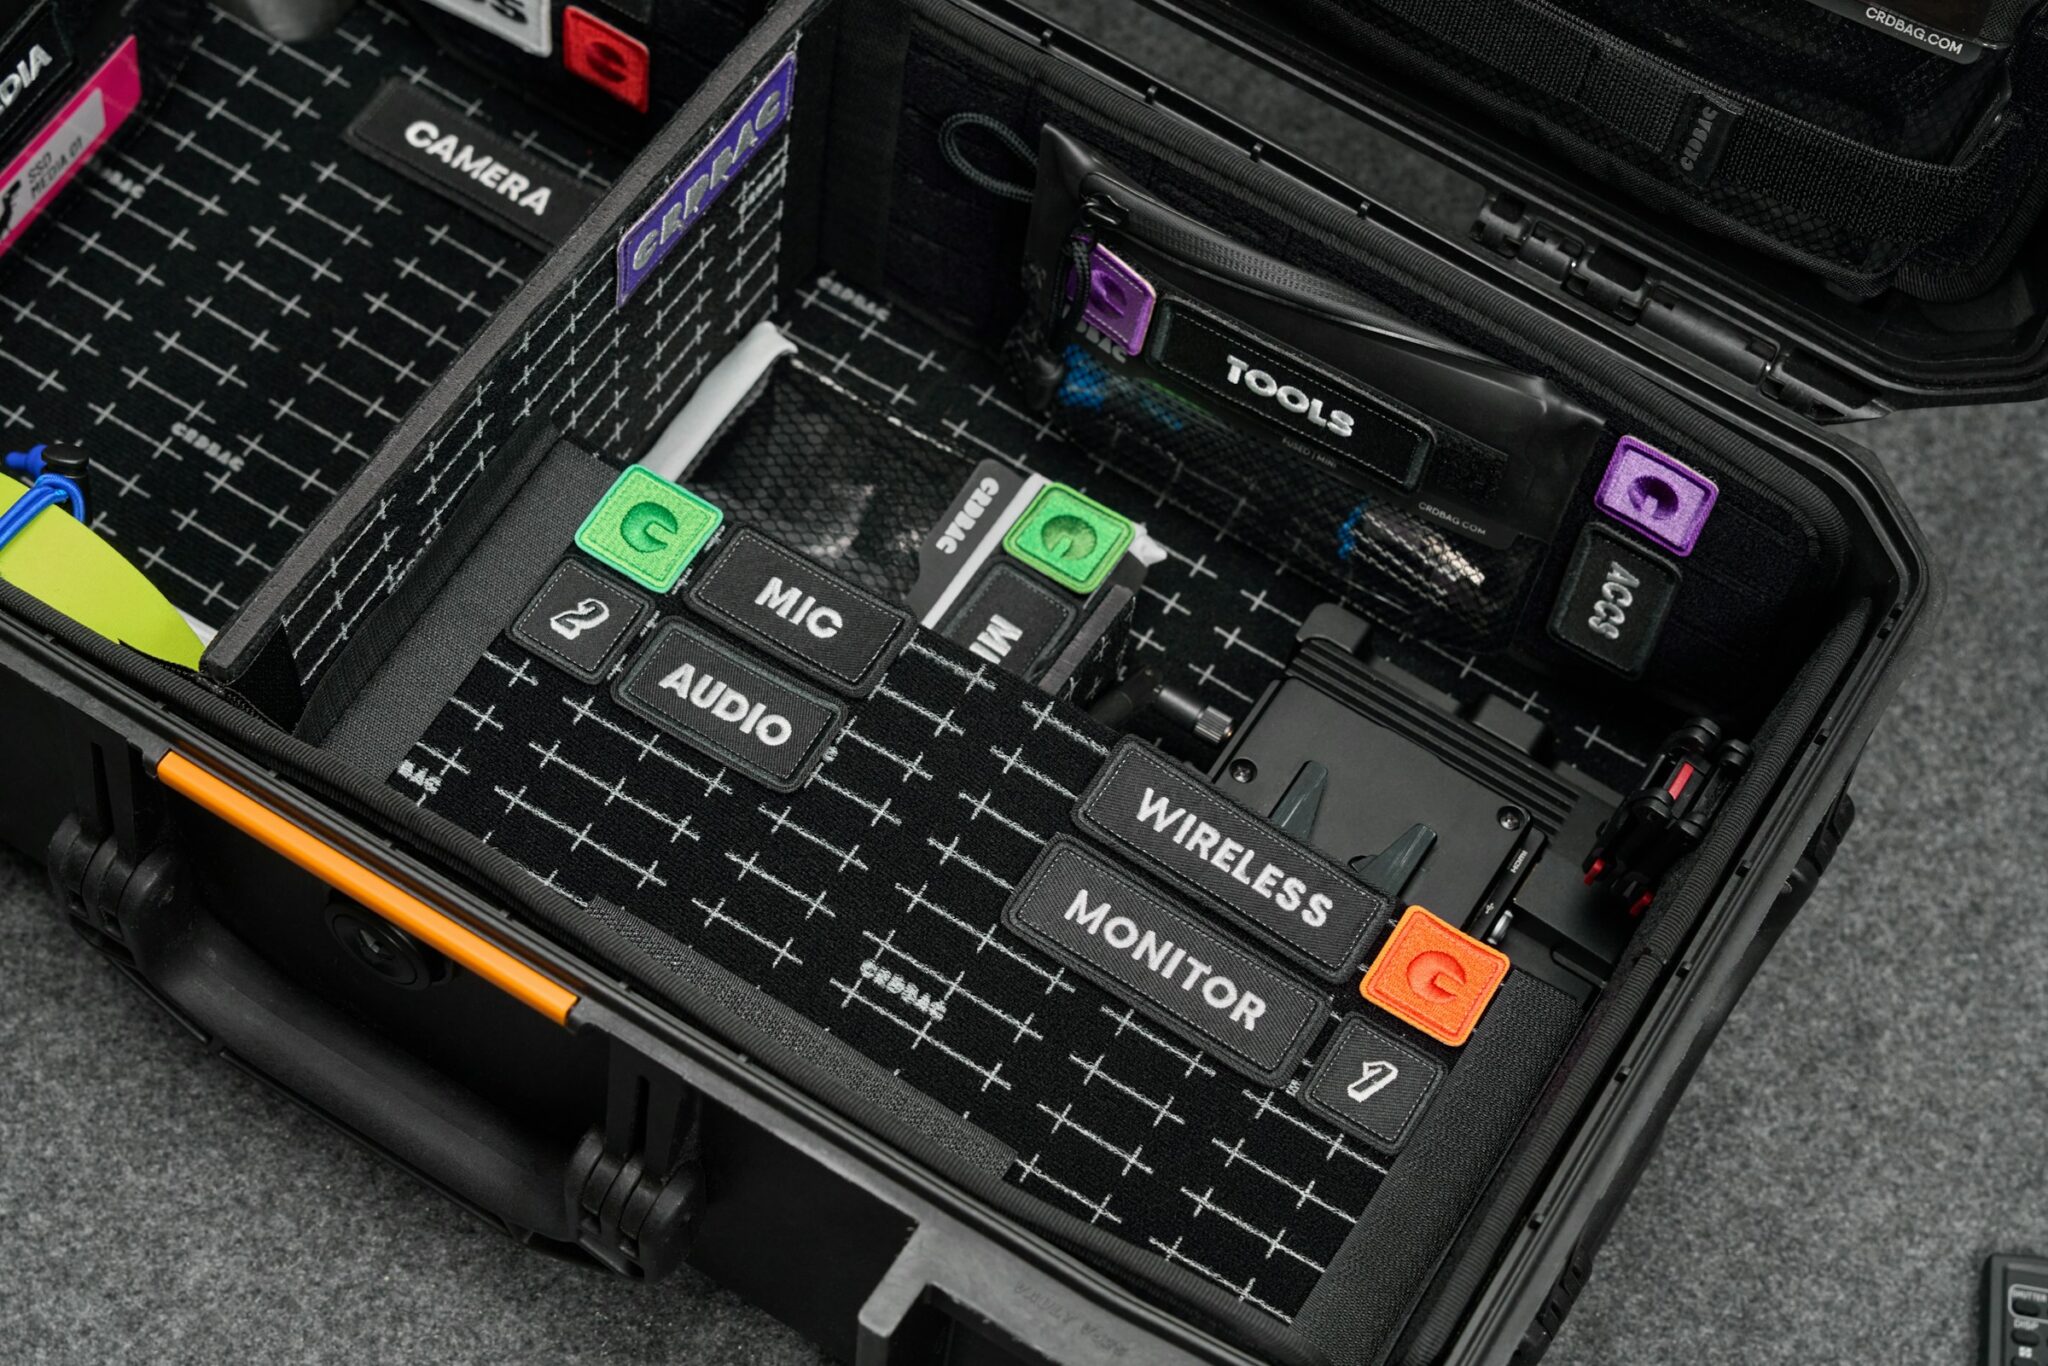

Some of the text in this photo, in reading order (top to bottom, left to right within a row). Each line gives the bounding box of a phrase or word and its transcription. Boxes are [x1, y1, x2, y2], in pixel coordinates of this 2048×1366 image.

[1865, 7, 1963, 55] CRDBAG.COM
[0, 44, 53, 113] DIA
[405, 120, 551, 216] CAMERA
[1680, 106, 1719, 171] CRDBAG
[31, 154, 68, 199] MEDIA
[1227, 354, 1354, 437] TOOLS
[936, 477, 999, 554] CRDBAG
[550, 598, 610, 640] 2
[755, 576, 844, 639] MIC
[1588, 561, 1640, 639] ACCS
[658, 663, 792, 746] AUDIO
[1135, 787, 1333, 927] WIRELESS
[1063, 889, 1266, 1031] MONITOR
[1347, 1061, 1399, 1103] 1
